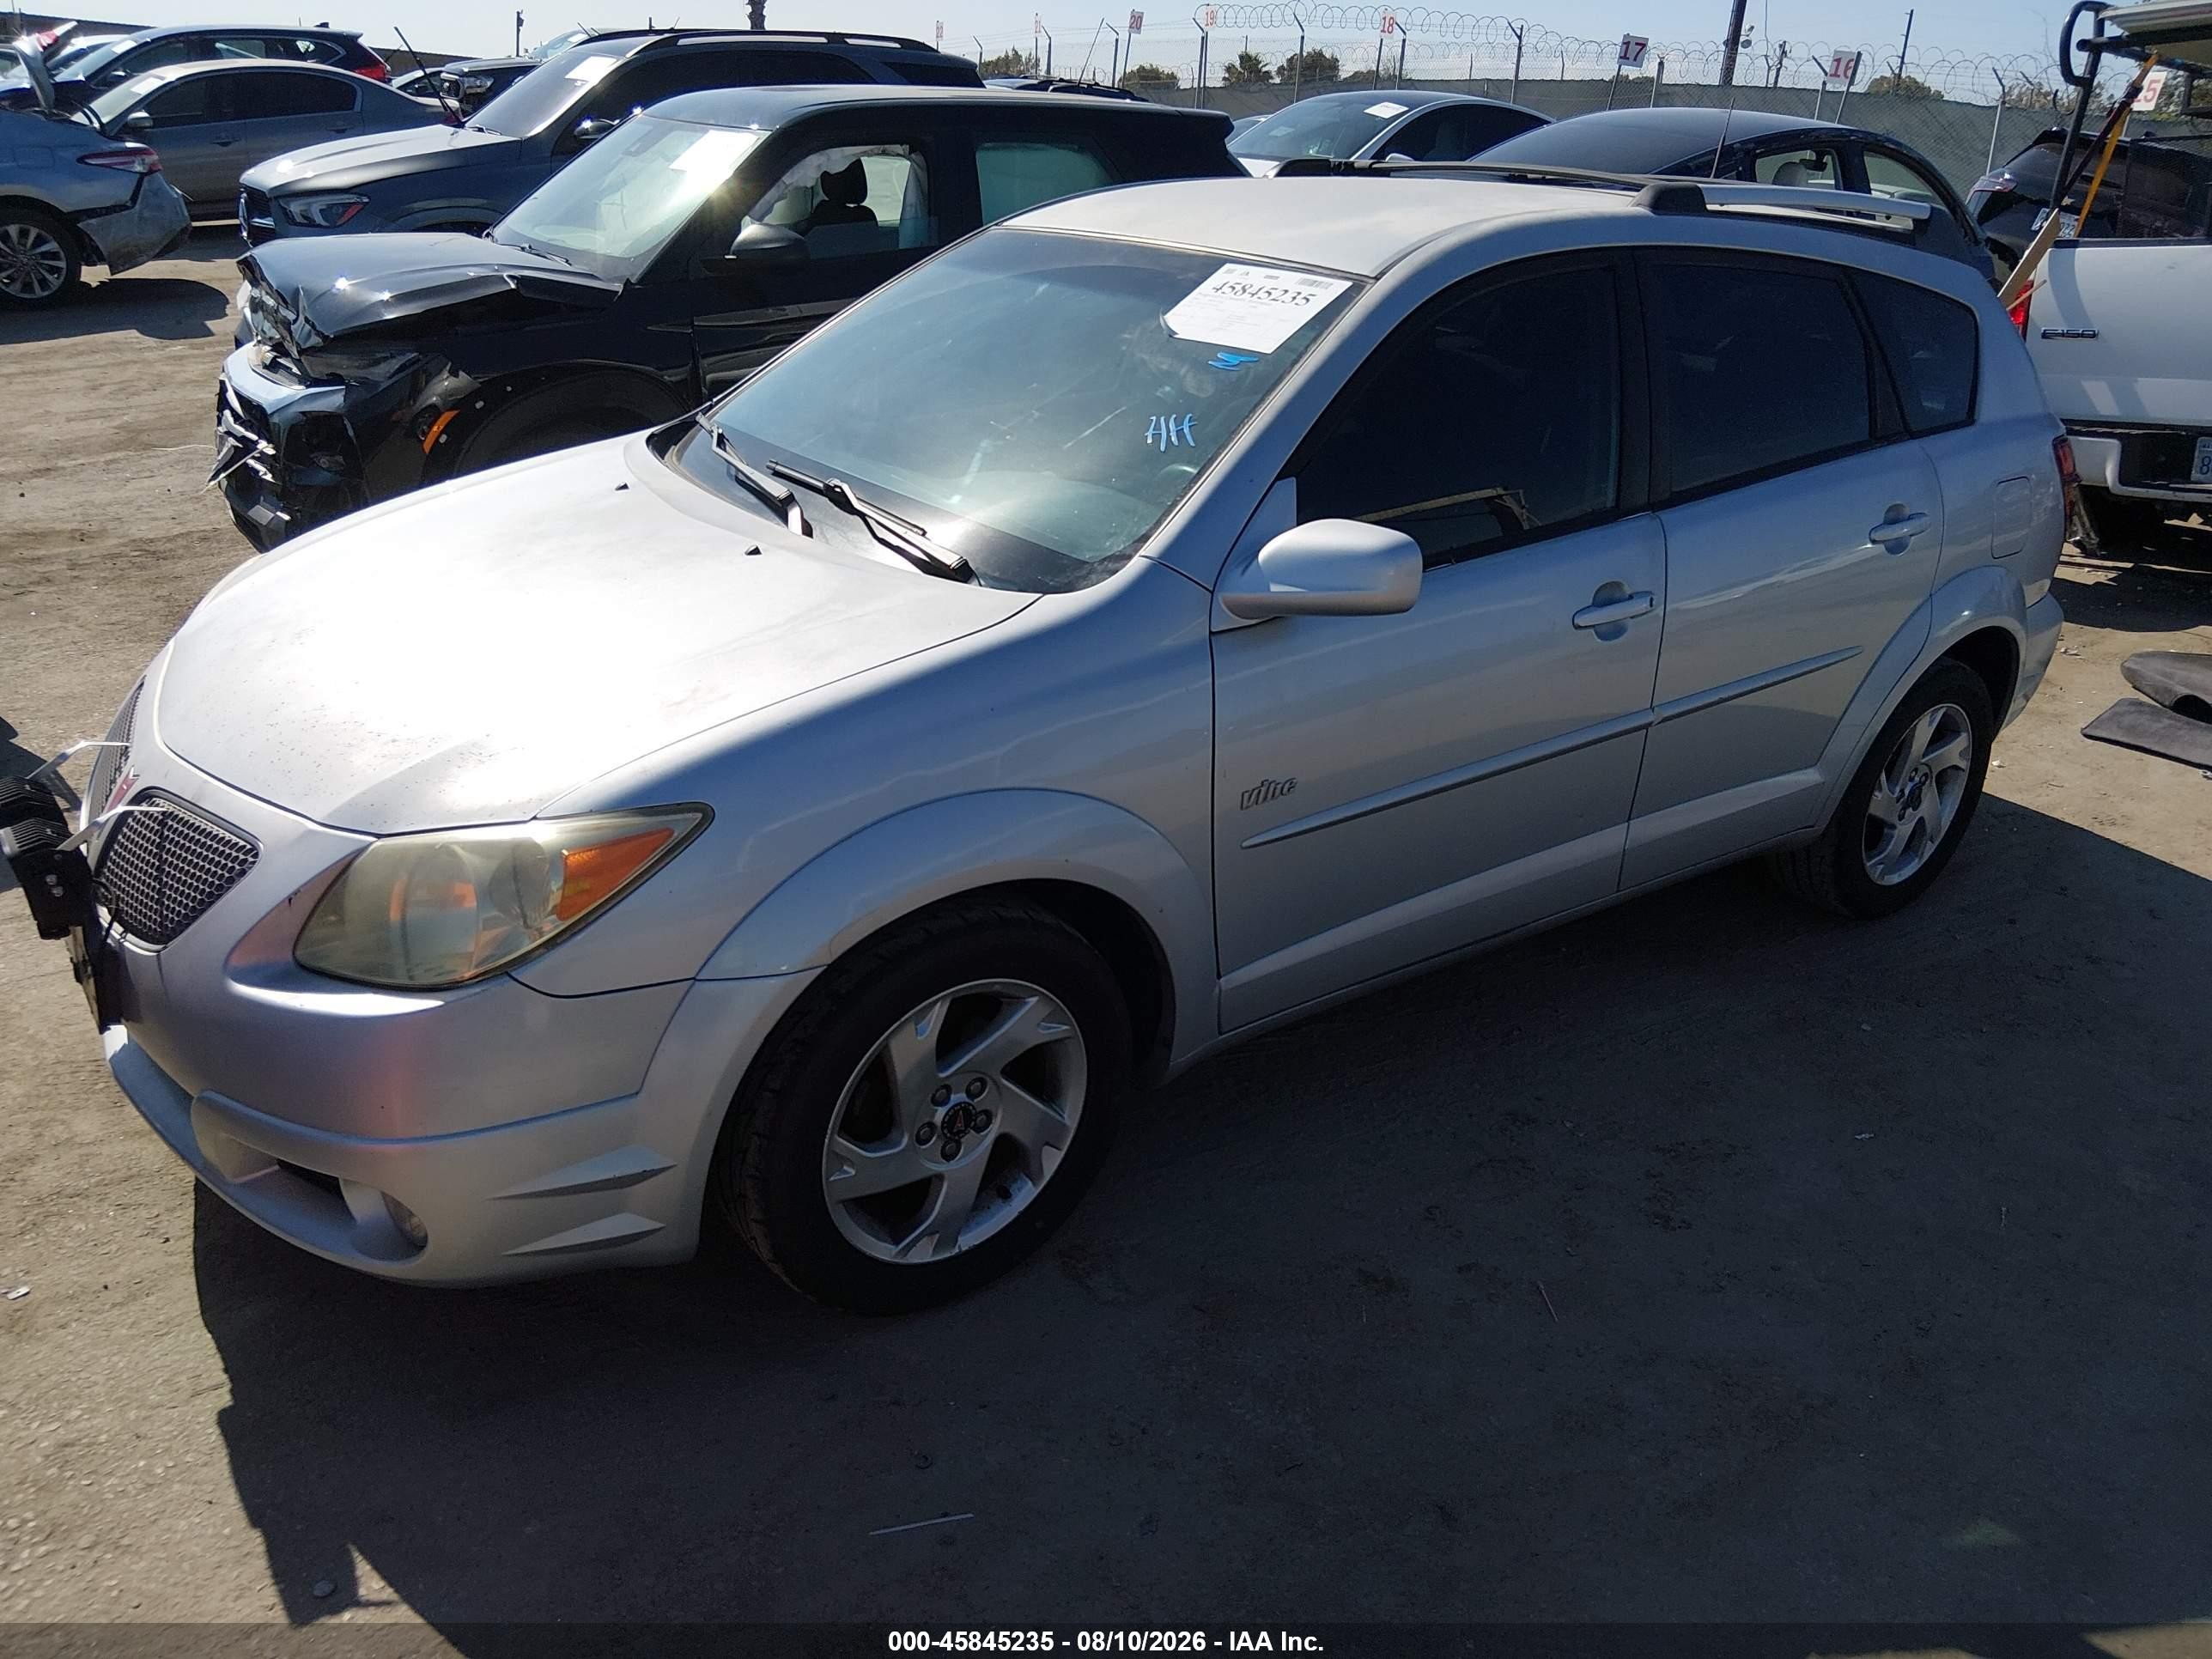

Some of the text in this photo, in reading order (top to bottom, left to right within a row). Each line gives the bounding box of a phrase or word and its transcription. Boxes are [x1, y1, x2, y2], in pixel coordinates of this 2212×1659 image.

[1035, 20, 1042, 33] 21
[1129, 15, 1143, 30] 20
[1205, 10, 1215, 27] 19
[1380, 15, 1395, 34] 18
[936, 26, 944, 39] 22
[1620, 40, 1647, 62] 17
[1212, 281, 1316, 307] 45845235
